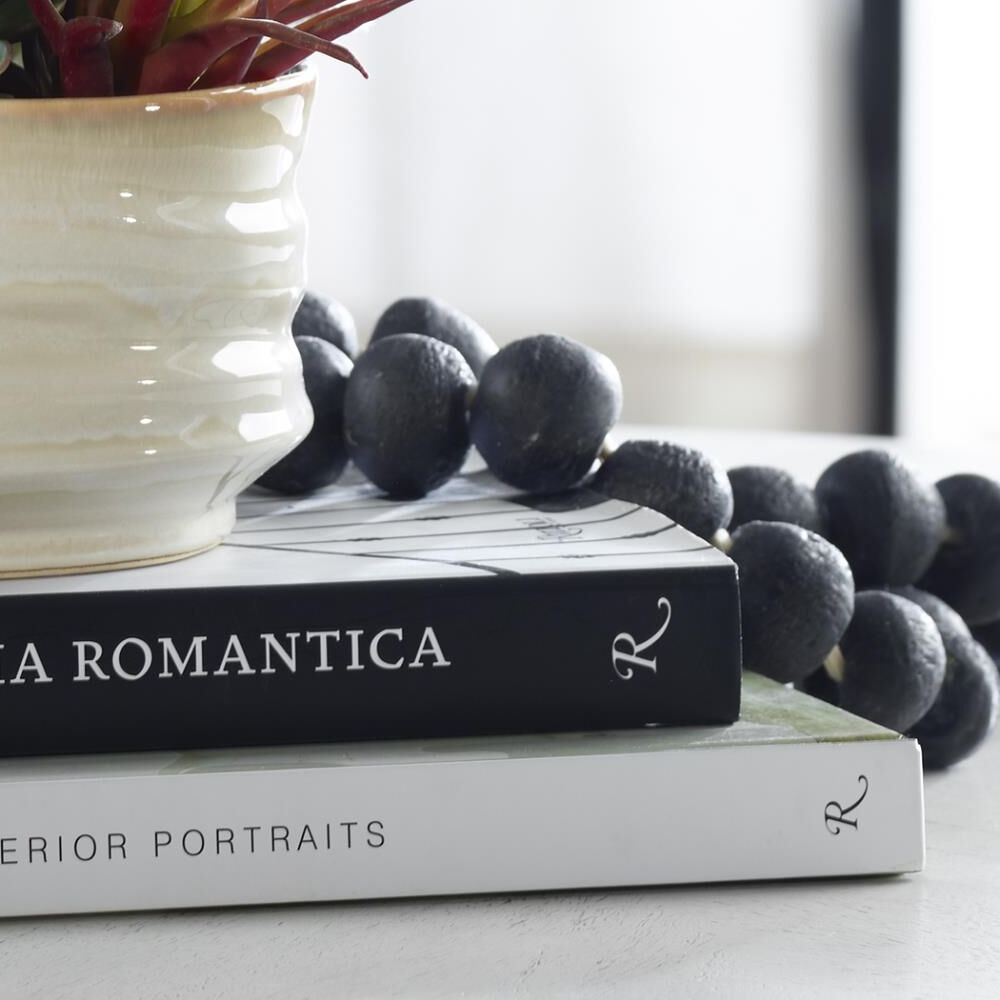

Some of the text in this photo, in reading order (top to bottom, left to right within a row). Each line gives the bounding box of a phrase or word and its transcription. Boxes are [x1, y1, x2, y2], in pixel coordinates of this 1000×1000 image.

[71, 625, 453, 683] ROMANTICA
[610, 595, 673, 681] R
[822, 773, 870, 837] R
[153, 819, 386, 860] PORTRAITS
